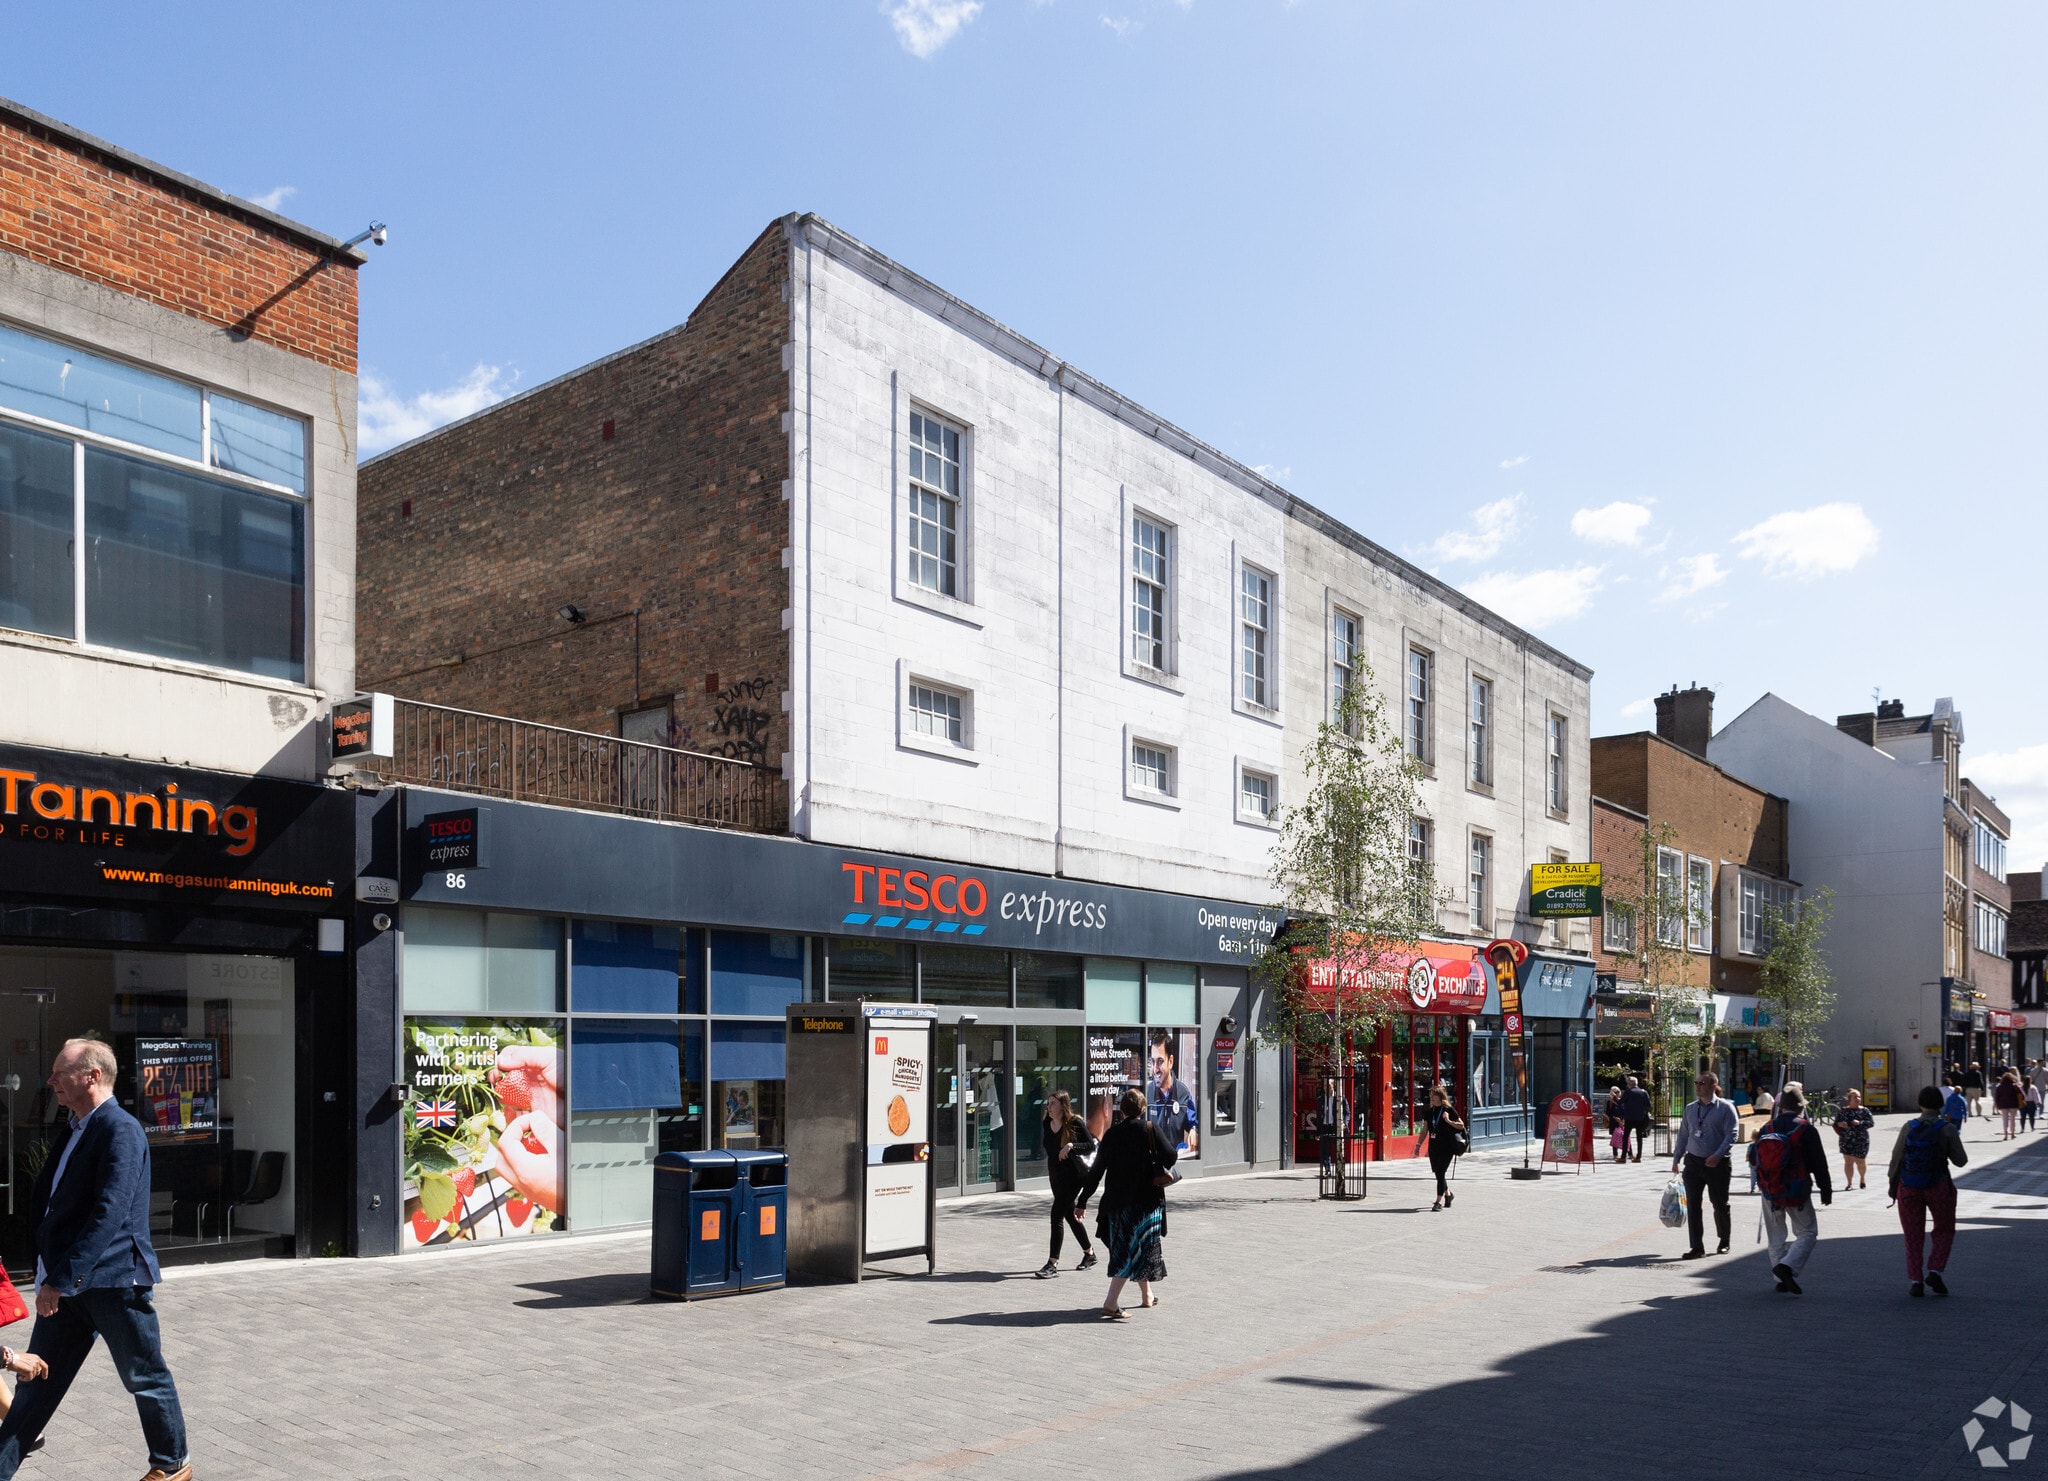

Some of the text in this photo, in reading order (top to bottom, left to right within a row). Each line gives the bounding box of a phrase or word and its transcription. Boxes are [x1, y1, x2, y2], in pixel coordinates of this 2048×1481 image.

[333, 711, 371, 731] MegaSun
[337, 730, 368, 747] Tanning
[0, 768, 258, 857] Tanning
[20, 823, 65, 841] FOR
[79, 829, 125, 847] LIFE
[429, 818, 472, 837] TESCO
[430, 845, 470, 863] express
[1541, 865, 1591, 874] FOR SALE
[103, 867, 333, 898] www.megasuntanninguk.com
[446, 873, 467, 889] 86
[842, 861, 1107, 935] TESCO express
[1545, 888, 1585, 899] Cradick
[1198, 907, 1278, 938] Open every day
[1438, 975, 1485, 996] EXCHANGE
[802, 1017, 844, 1033] Telephone
[141, 1042, 180, 1051] MegaSun
[180, 1042, 212, 1051] Tanning
[415, 1031, 499, 1051] Partnering
[1089, 1036, 1114, 1048] Serving
[142, 1055, 214, 1065] THIS WEEKS OFFER
[415, 1051, 501, 1067] with British
[1089, 1048, 1132, 1059] Week Street's
[896, 1056, 921, 1070] SPICY
[1089, 1061, 1120, 1073] shoppers
[143, 1063, 213, 1097] 25% OFF
[415, 1070, 478, 1087] farmers
[1094, 1073, 1109, 1083] little
[1109, 1073, 1130, 1082] better
[1089, 1085, 1120, 1096] every day
[188, 1121, 213, 1129] CREAM
